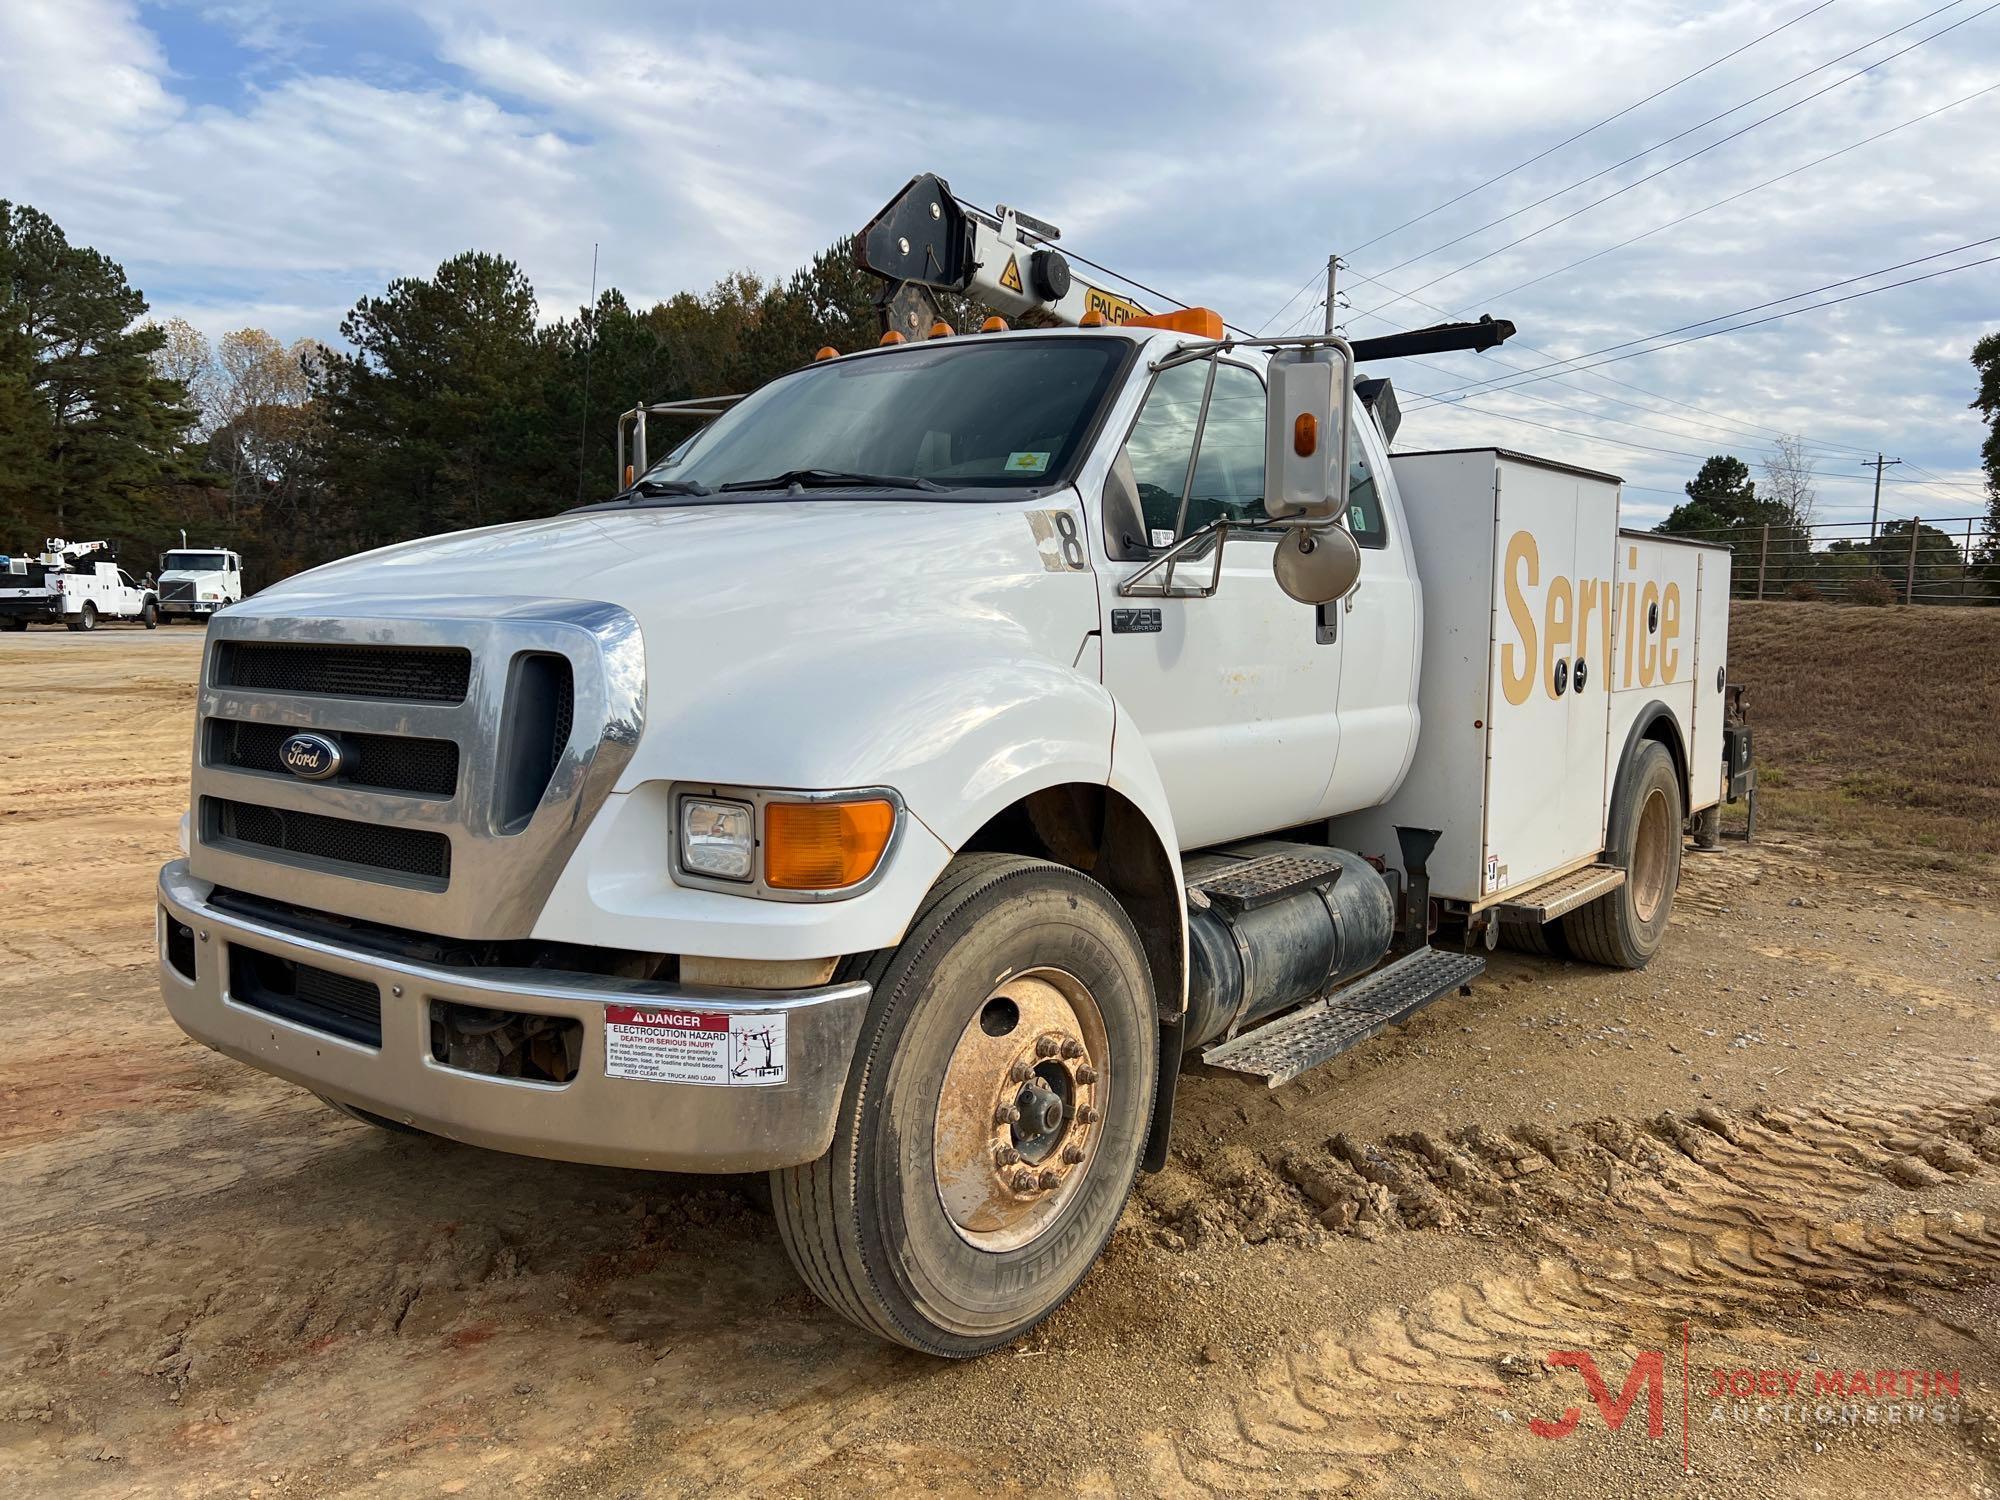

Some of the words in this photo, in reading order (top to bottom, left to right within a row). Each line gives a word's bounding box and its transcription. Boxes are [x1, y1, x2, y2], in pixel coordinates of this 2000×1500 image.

[1090, 294, 1139, 324] PALFIN
[1055, 511, 1084, 570] 8
[1501, 530, 1680, 705] Service
[288, 741, 320, 767] Ford
[613, 1024, 687, 1039] ELECTROCUTION
[690, 1031, 726, 1041] HAZARD
[647, 1013, 700, 1027] DANGER
[656, 1038, 687, 1047] SERIOUS
[688, 1040, 714, 1048] INJURY
[998, 1182, 1106, 1296] MICHELIN
